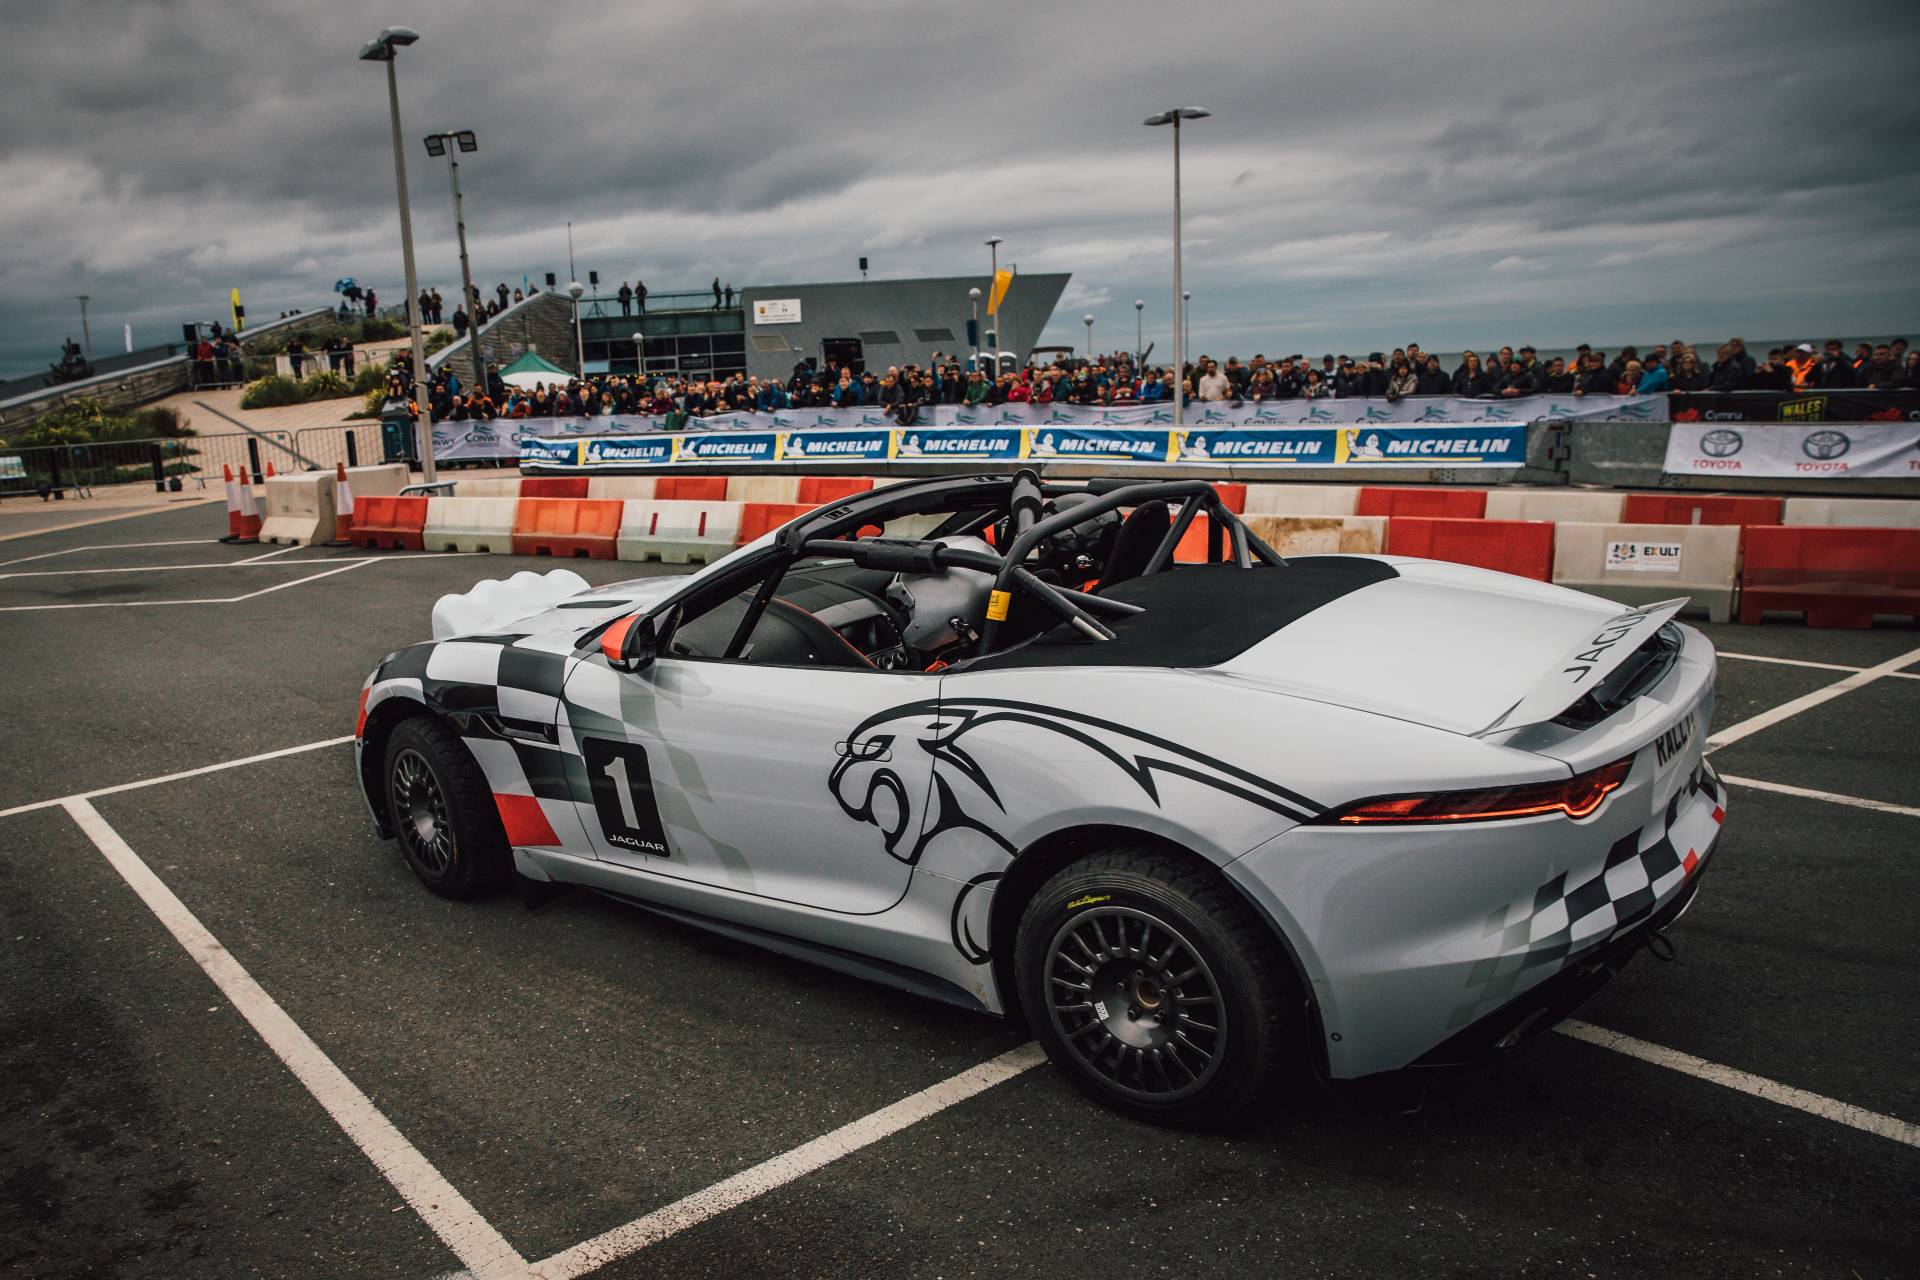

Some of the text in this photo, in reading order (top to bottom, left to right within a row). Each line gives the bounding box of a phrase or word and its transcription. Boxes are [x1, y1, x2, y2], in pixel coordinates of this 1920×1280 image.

[1782, 399, 1822, 416] WALES
[1704, 410, 1743, 422] Cymru
[699, 443, 767, 455] MICHELIN
[806, 440, 882, 453] MICHELIN
[924, 439, 1010, 452] MICHELIN
[1059, 438, 1156, 454] MICHELIN
[1212, 441, 1322, 455] MICHELIN
[1386, 438, 1511, 454] MICHELIN
[602, 447, 665, 458] MICHELIN
[1693, 459, 1742, 470] TOYOTA
[1795, 462, 1850, 472] TOYOTA
[1643, 546, 1680, 557] EXULT
[604, 756, 640, 830] 1
[609, 834, 665, 852] JAGUAR
